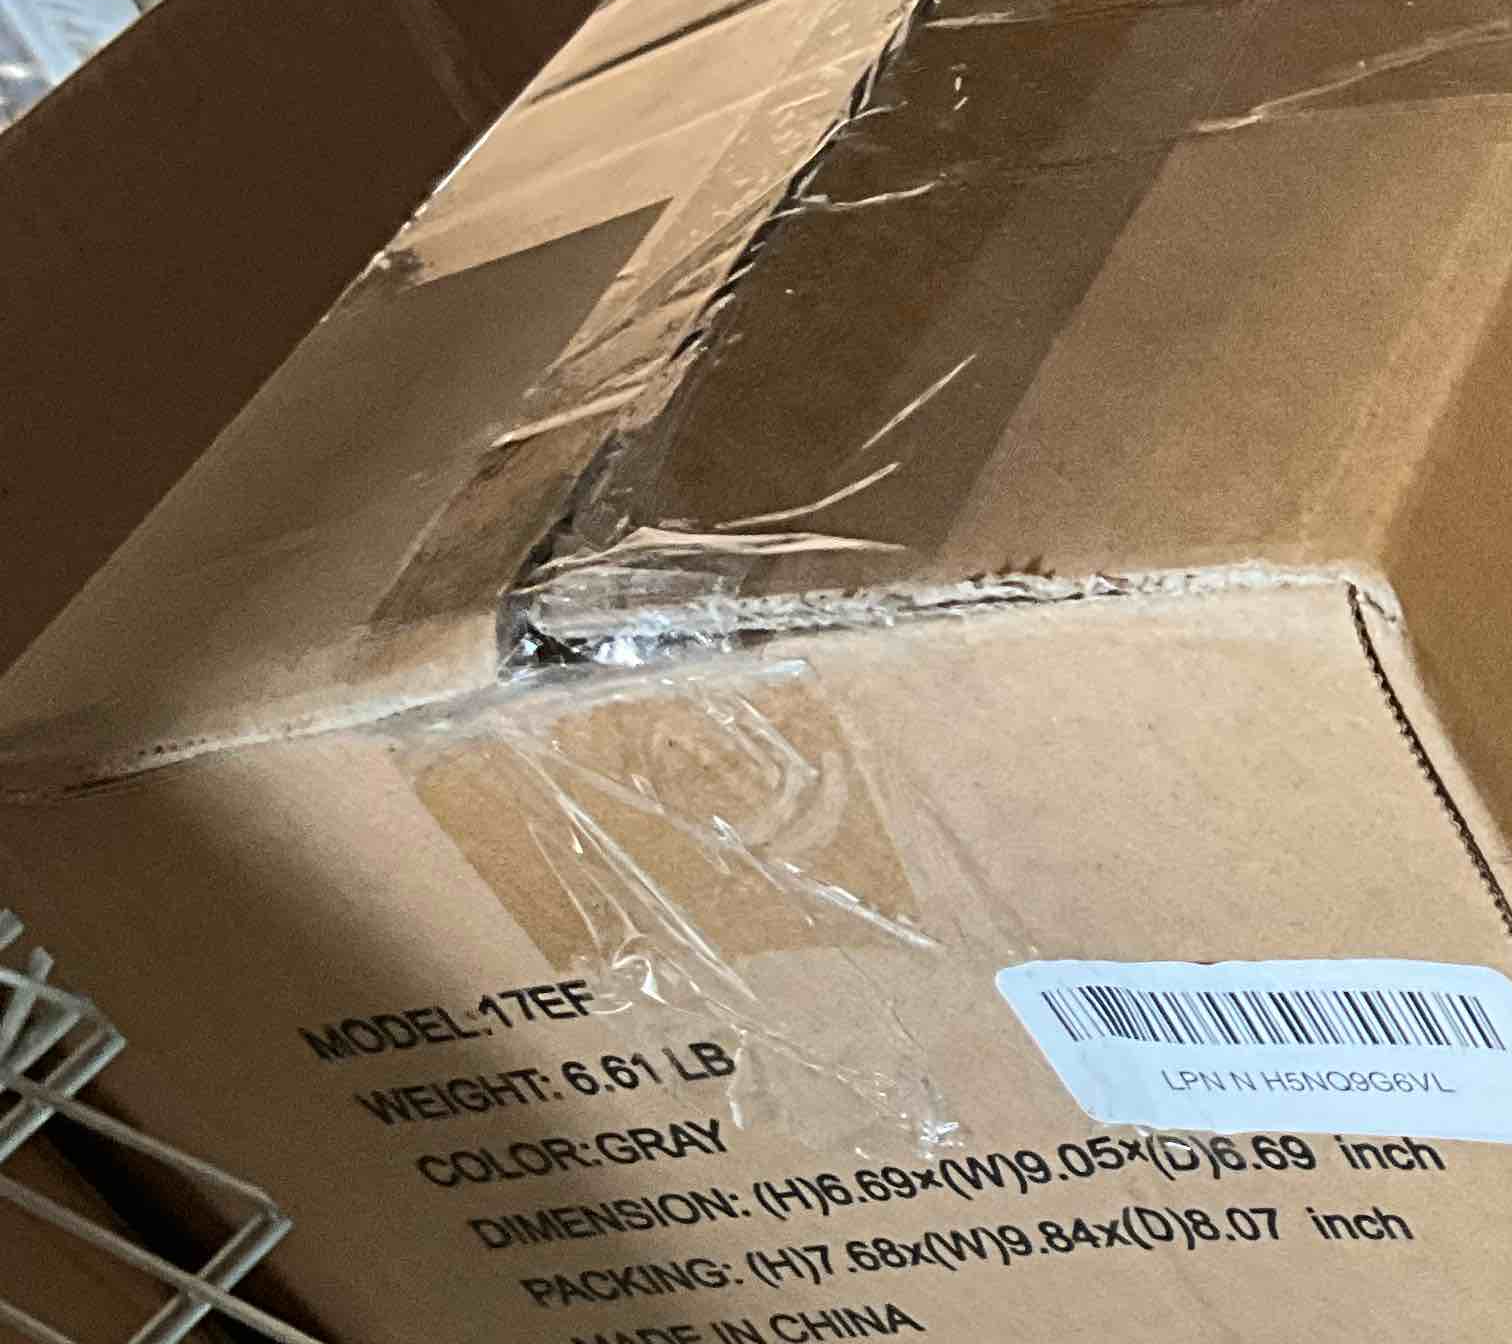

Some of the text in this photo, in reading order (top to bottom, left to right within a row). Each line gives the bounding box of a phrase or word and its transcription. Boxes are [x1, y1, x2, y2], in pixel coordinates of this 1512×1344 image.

[355, 1041, 736, 1125] WEIGHT: 6.61 LB
[1161, 1069, 1226, 1092] LPN
[1230, 1071, 1257, 1092] N
[417, 1118, 728, 1188] COLOR:GRAY
[467, 1187, 751, 1251] DIMENSION:
[1333, 1135, 1446, 1171] inch
[521, 1258, 745, 1310] PACKING:
[1306, 1206, 1414, 1241] inch
